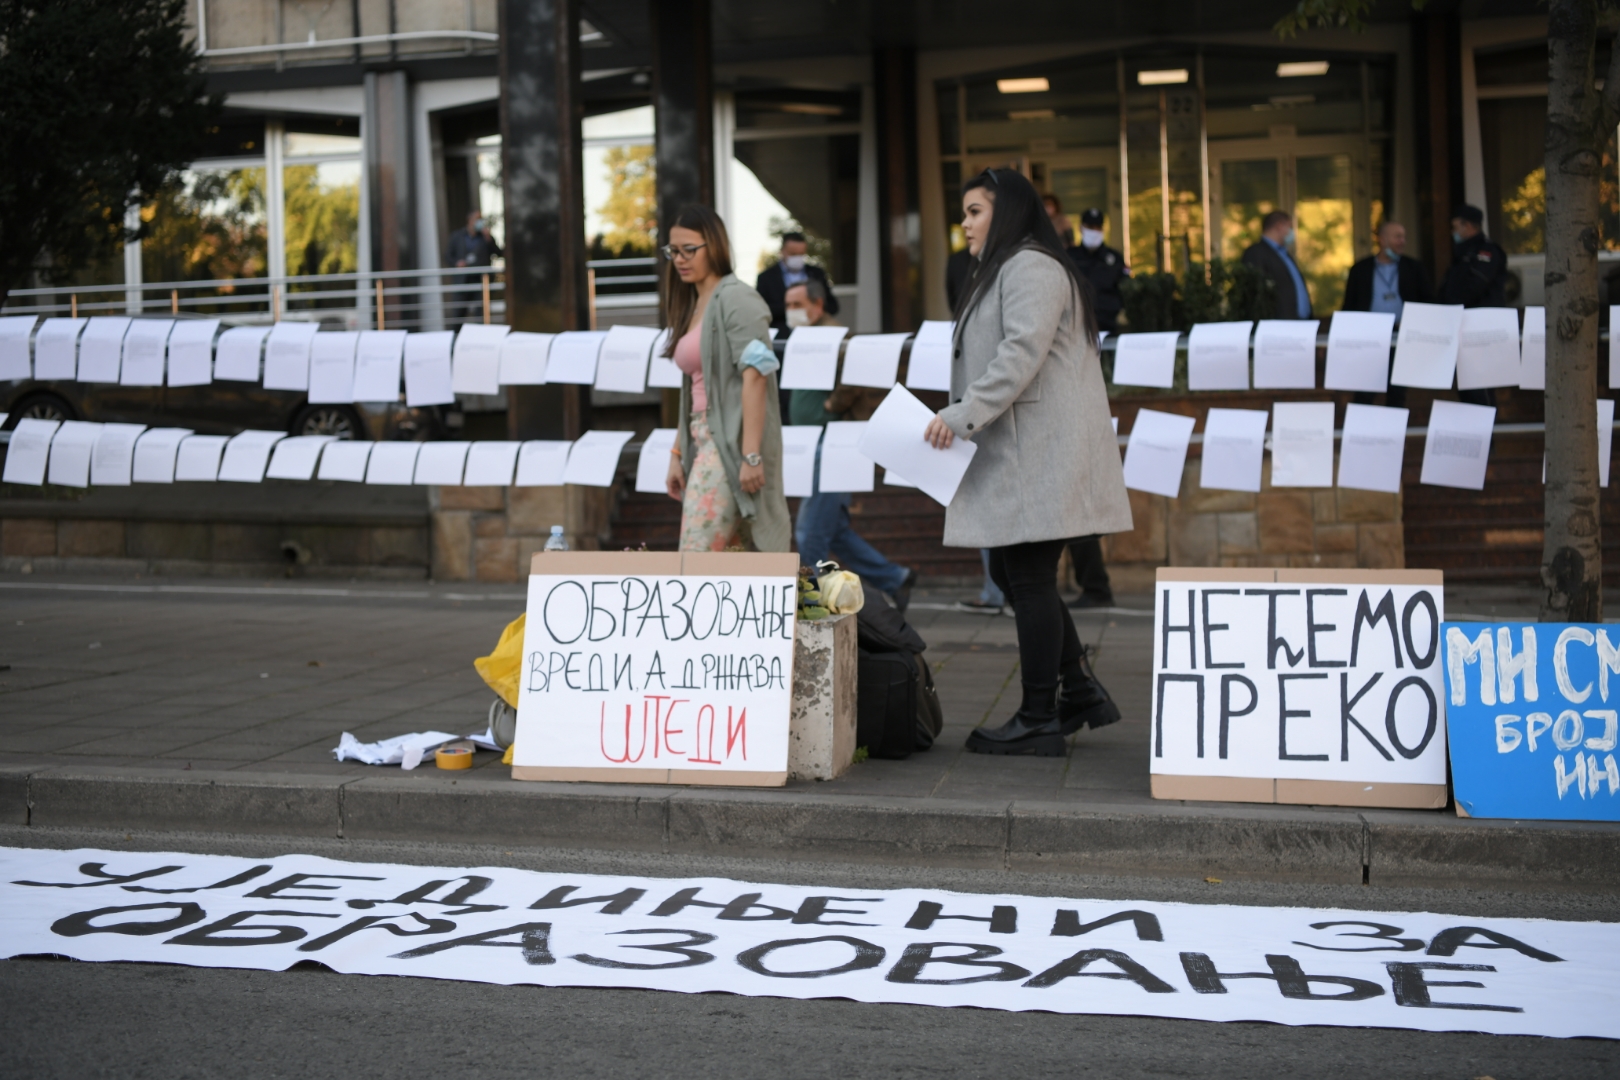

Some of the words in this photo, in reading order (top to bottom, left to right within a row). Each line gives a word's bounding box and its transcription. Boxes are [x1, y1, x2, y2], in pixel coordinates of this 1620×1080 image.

[543, 577, 794, 645] ОБРАЗОВАЊЕ
[644, 650, 666, 690] А
[671, 653, 785, 692] ДРЖАВА
[1446, 626, 1539, 706] МИ
[601, 695, 747, 765] ШТЕДИ
[1155, 672, 1438, 762] ПРЕКО
[1495, 709, 1618, 754] БРОЈ
[9, 862, 1163, 942] УЈЕДИЊЕНИ
[1291, 921, 1568, 963] ЗА
[50, 901, 1525, 1013] ОБРАЗОВАЊЕ
